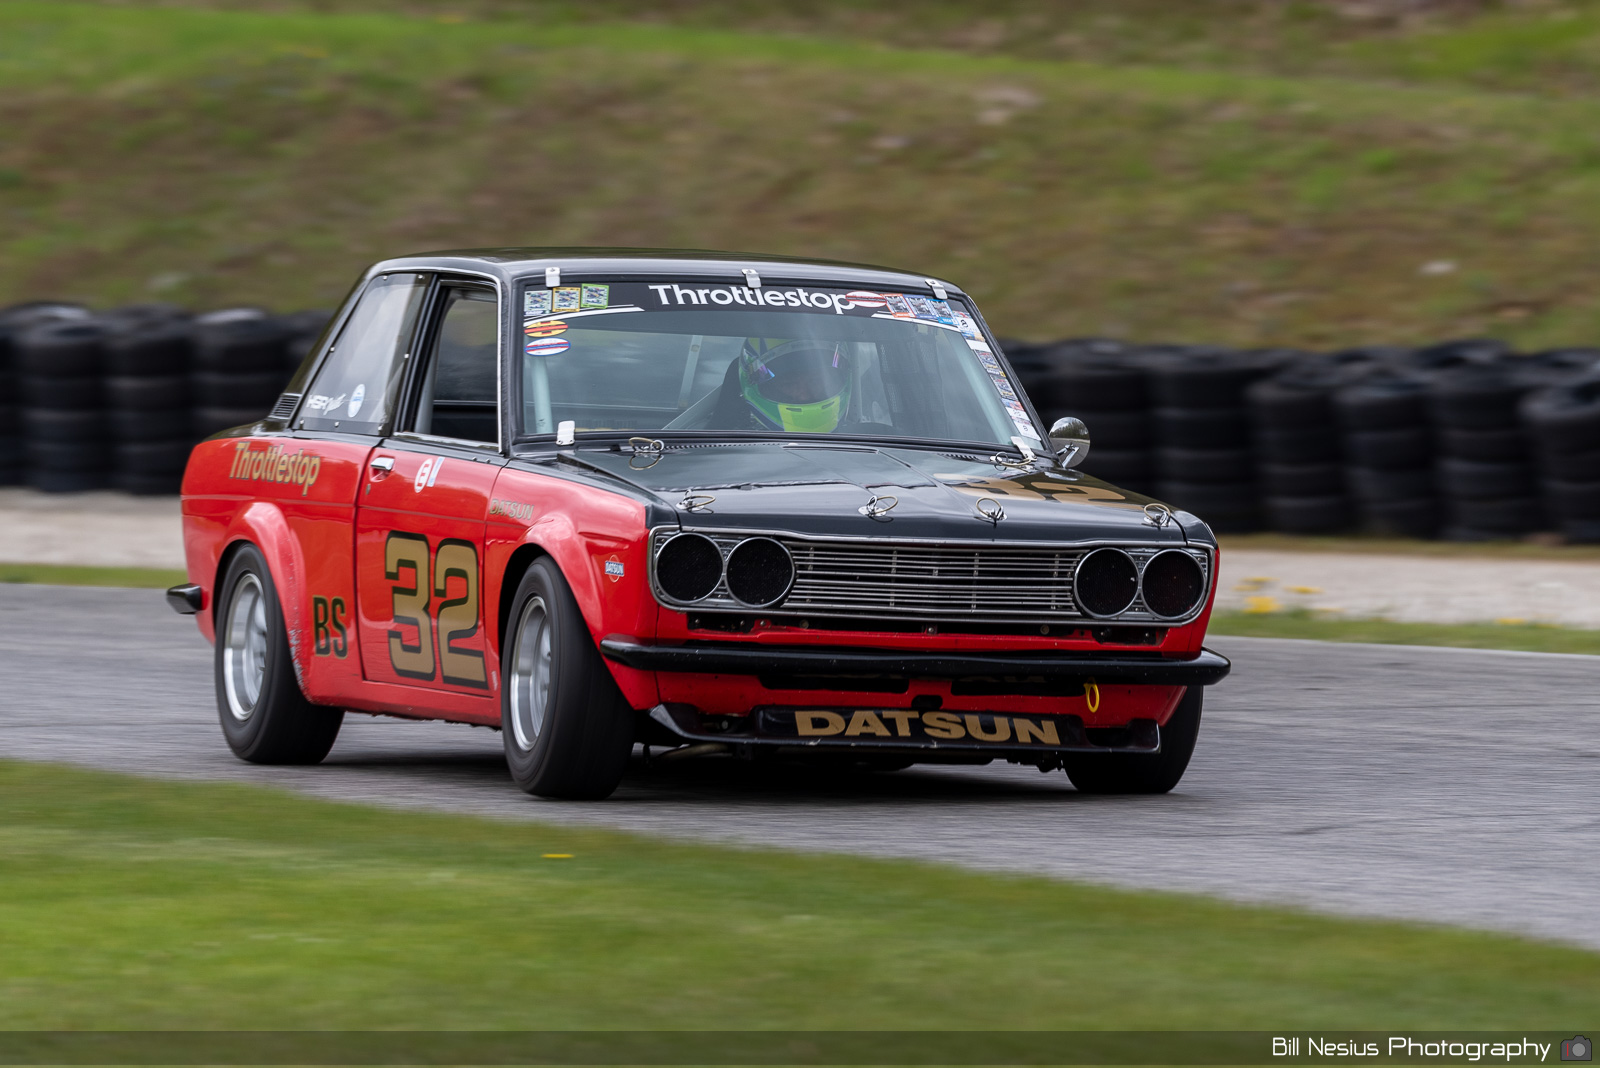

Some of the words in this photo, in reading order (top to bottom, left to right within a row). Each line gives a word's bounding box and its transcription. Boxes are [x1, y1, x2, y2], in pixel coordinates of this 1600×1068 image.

[648, 284, 855, 315] Throttlestop
[229, 441, 320, 496] Throttlestop
[489, 499, 535, 520] DATSUN
[312, 594, 348, 660] BS
[385, 530, 490, 690] 32
[794, 710, 1061, 745] DATSUN
